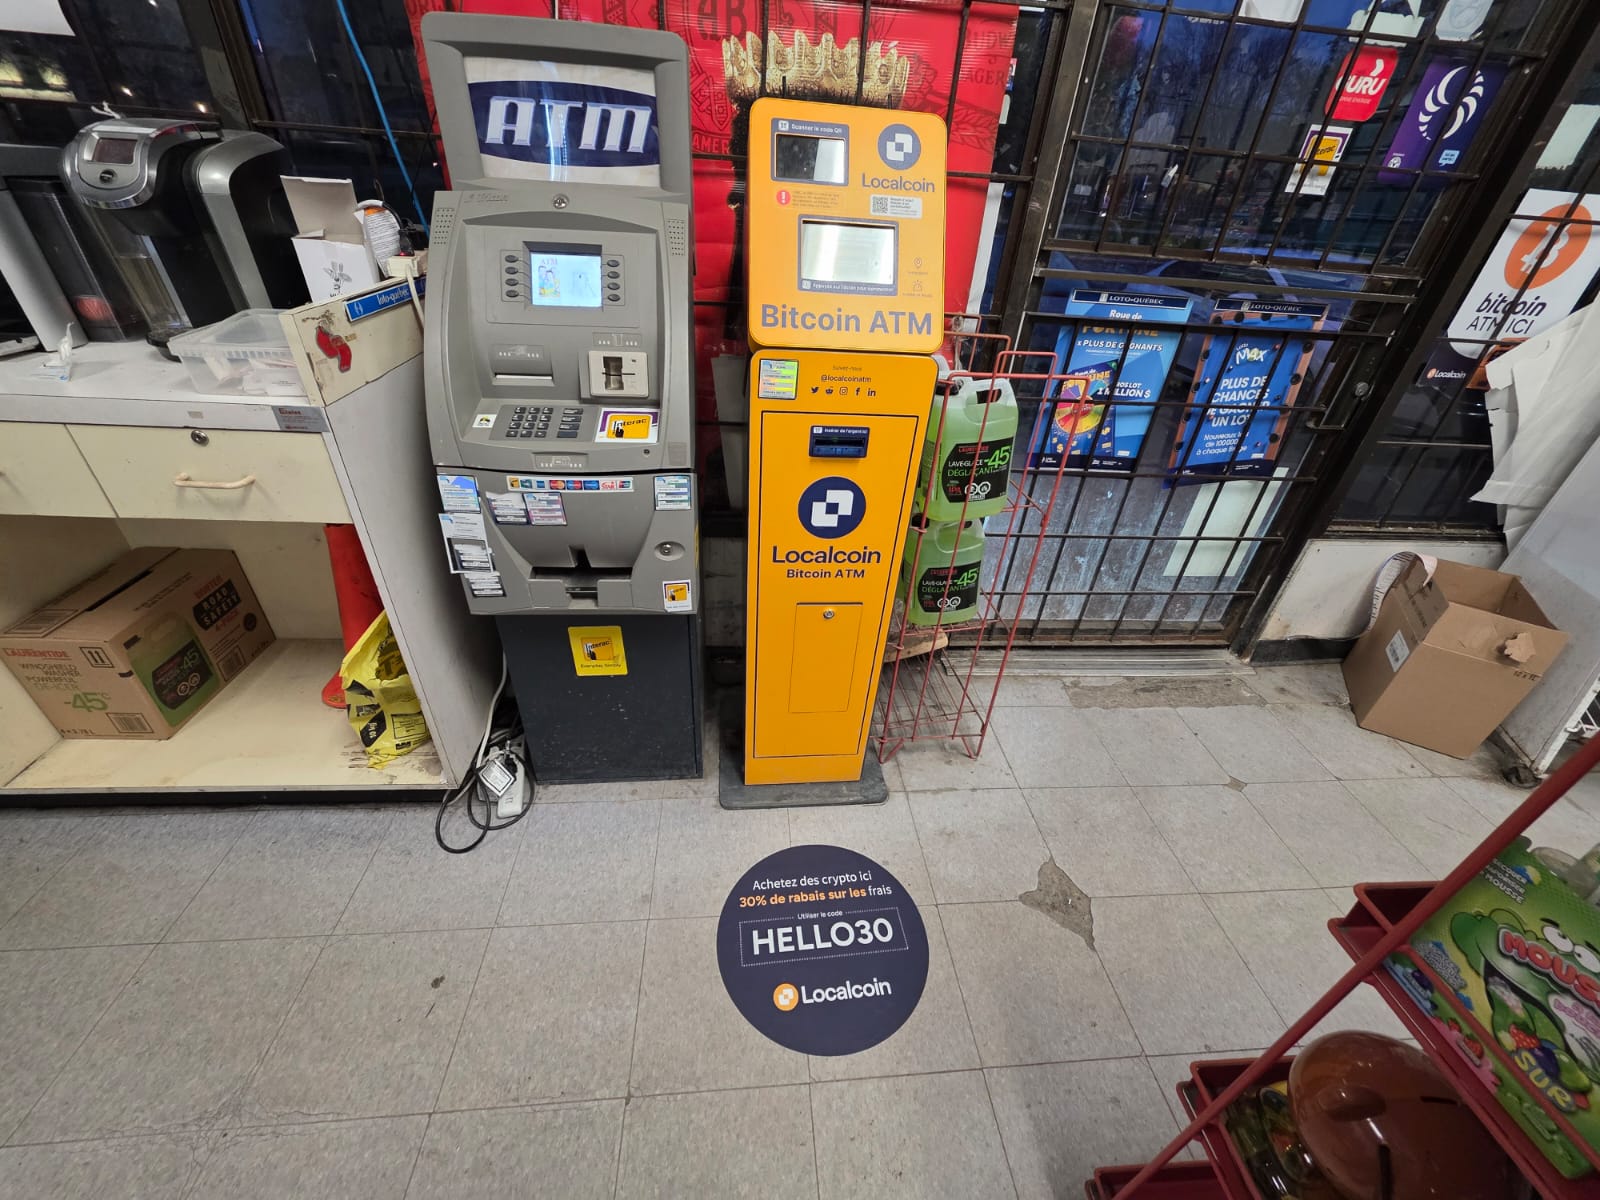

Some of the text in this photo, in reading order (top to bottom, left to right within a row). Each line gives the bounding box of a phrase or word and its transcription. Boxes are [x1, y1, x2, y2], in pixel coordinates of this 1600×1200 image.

[485, 96, 652, 153] ATM
[862, 173, 935, 192] Localcoin
[1108, 295, 1164, 305] LOTO-QUÉBEC
[761, 304, 932, 335] Bitcoin ATM
[1109, 310, 1130, 319] Roue
[1505, 318, 1535, 334] ICI
[1082, 340, 1104, 348] PLUS
[1105, 341, 1118, 349] DE
[1119, 342, 1163, 352] GGNANTS
[821, 374, 872, 383] @localcoinatm
[1221, 377, 1249, 390] PLUS
[1104, 388, 1143, 398] MLLION
[1211, 418, 1229, 428] UN
[772, 545, 881, 564] Localcoin
[786, 569, 865, 578] Bitcoin ATM
[753, 870, 872, 890] Achetez des crypto ici
[739, 884, 892, 908] 30% de rabais sur les frais
[797, 911, 819, 919] Utiliser
[752, 917, 893, 955] HELLO30
[801, 977, 892, 1004] Localcoin
